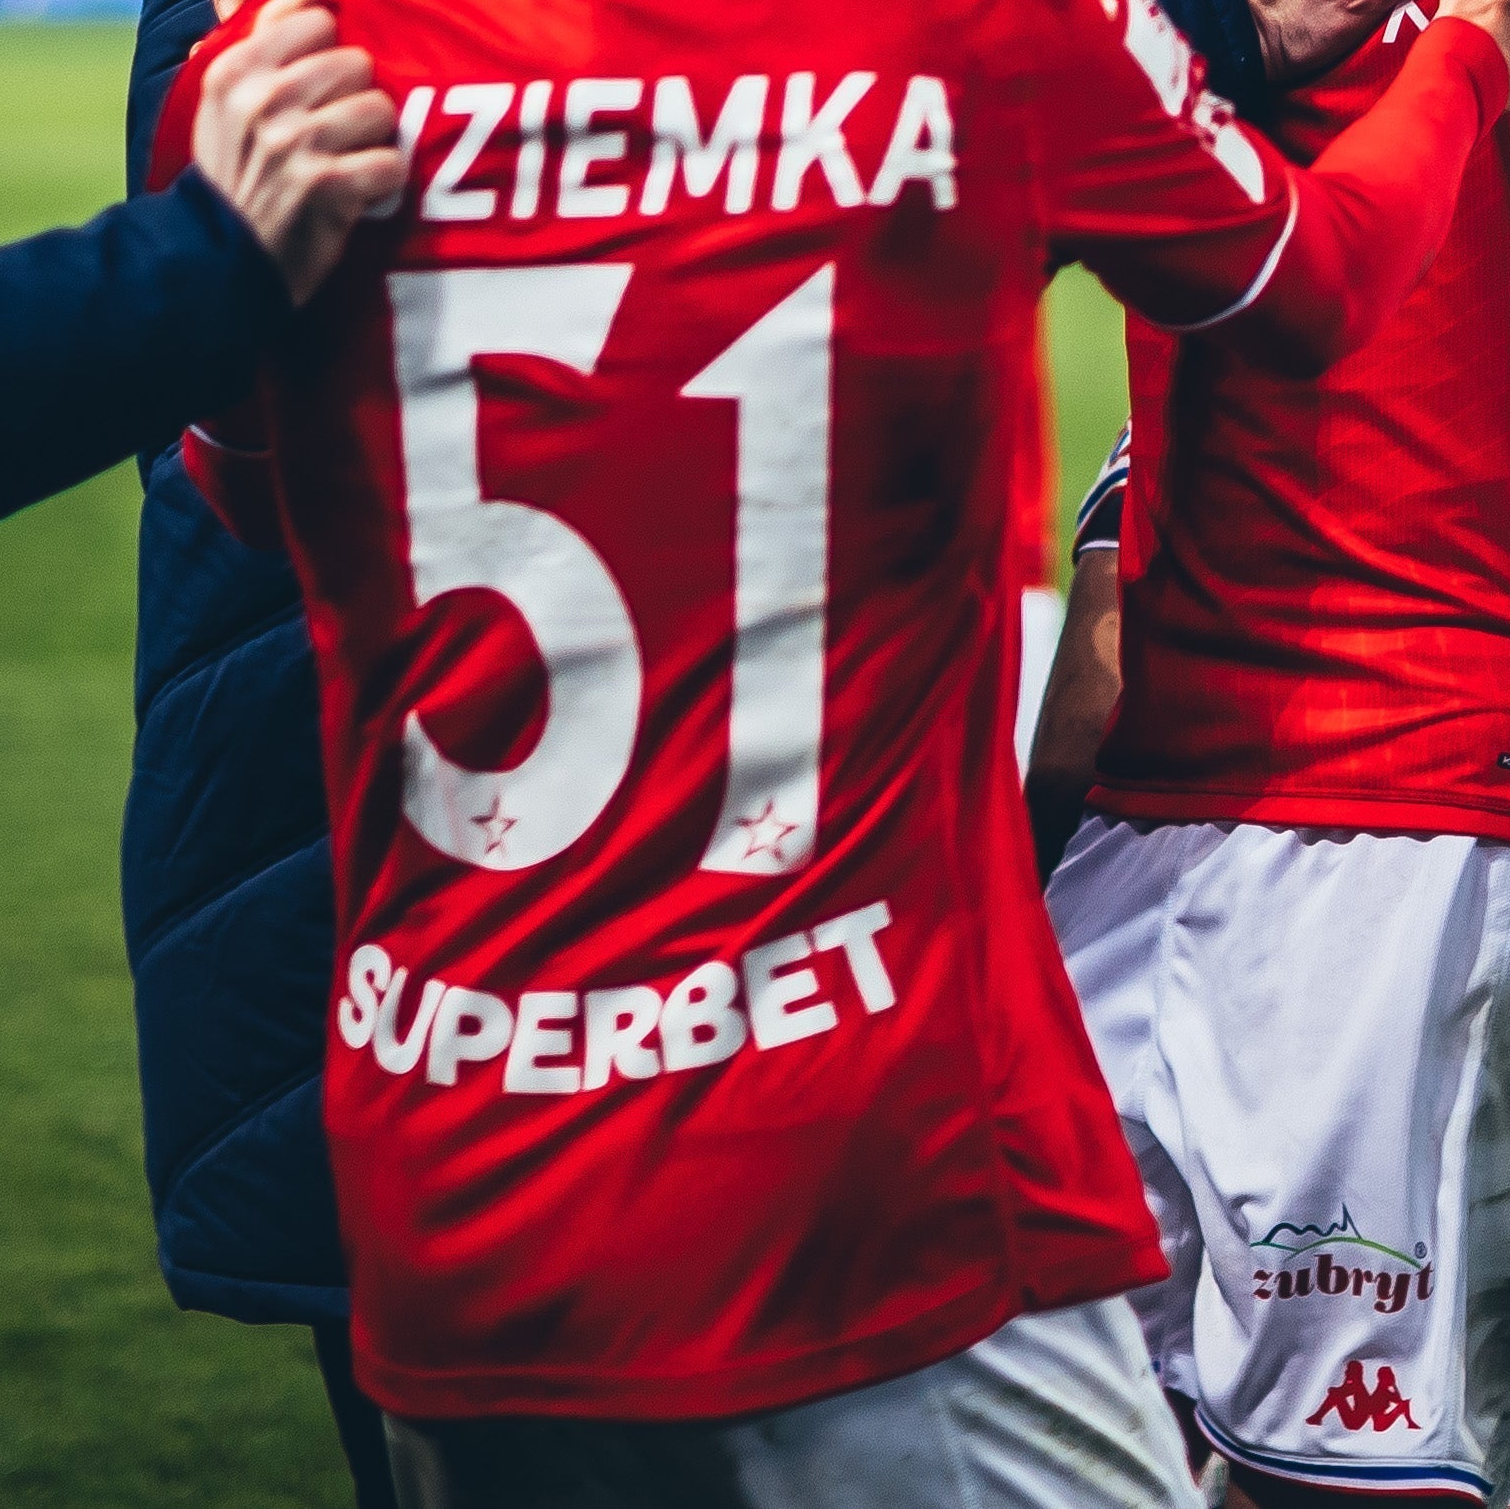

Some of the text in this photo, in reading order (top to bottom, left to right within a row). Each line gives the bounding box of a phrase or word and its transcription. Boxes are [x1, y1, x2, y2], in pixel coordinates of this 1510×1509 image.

[362, 71, 958, 222] ZIEMKA
[386, 261, 838, 875] 51
[337, 900, 897, 1094] SUPERBET
[1252, 1253, 1434, 1314] zubryt
